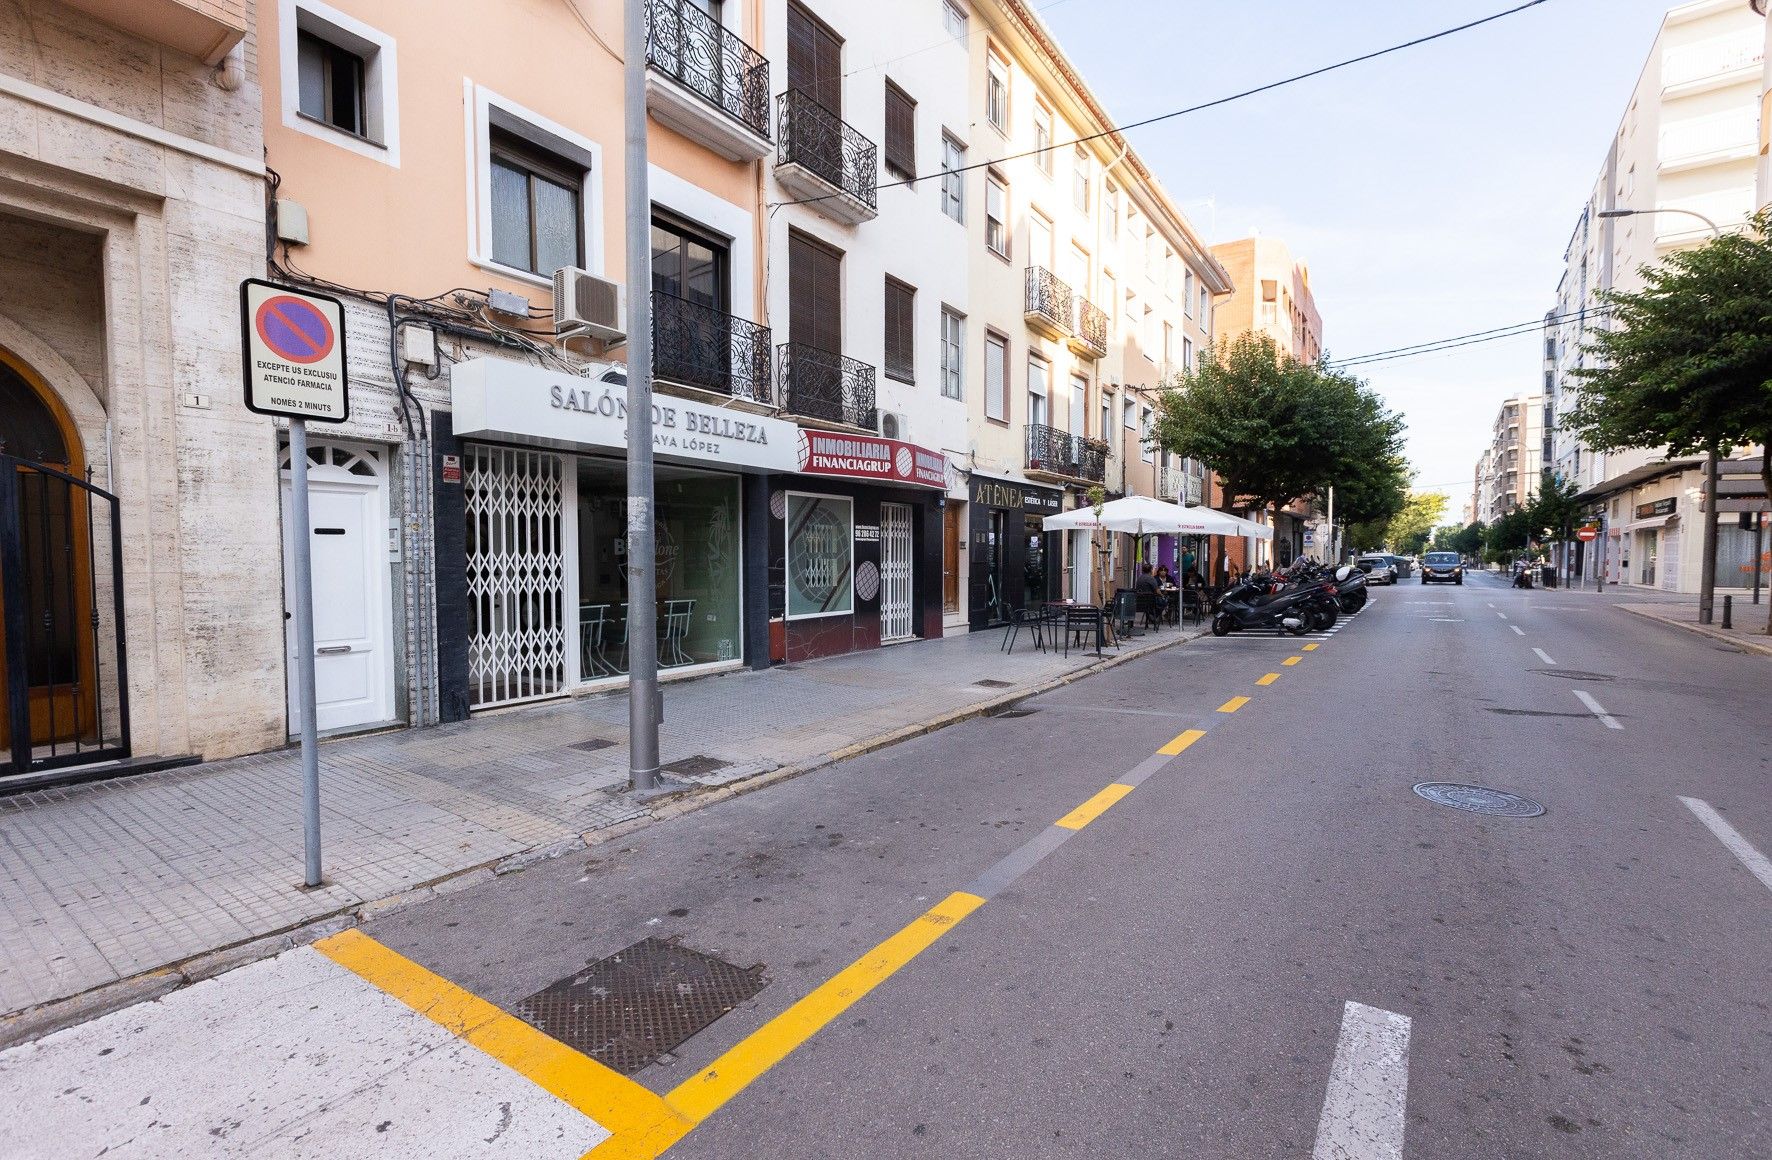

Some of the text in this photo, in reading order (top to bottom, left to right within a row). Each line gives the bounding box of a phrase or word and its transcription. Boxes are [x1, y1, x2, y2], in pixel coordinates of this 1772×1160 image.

[257, 360, 337, 380] EXCEPTE US EXCLUSIU
[297, 379, 333, 392] FARMACIA
[194, 396, 200, 406] 1
[271, 396, 332, 412] NOMÉS 2 MINUTS
[686, 410, 768, 445] BELLEZA
[682, 436, 720, 454] LÓPEZ
[812, 436, 891, 460] INMOBILIARIA
[812, 456, 892, 472] FINANCIAGRUP
[976, 484, 1024, 508] ATENEA
